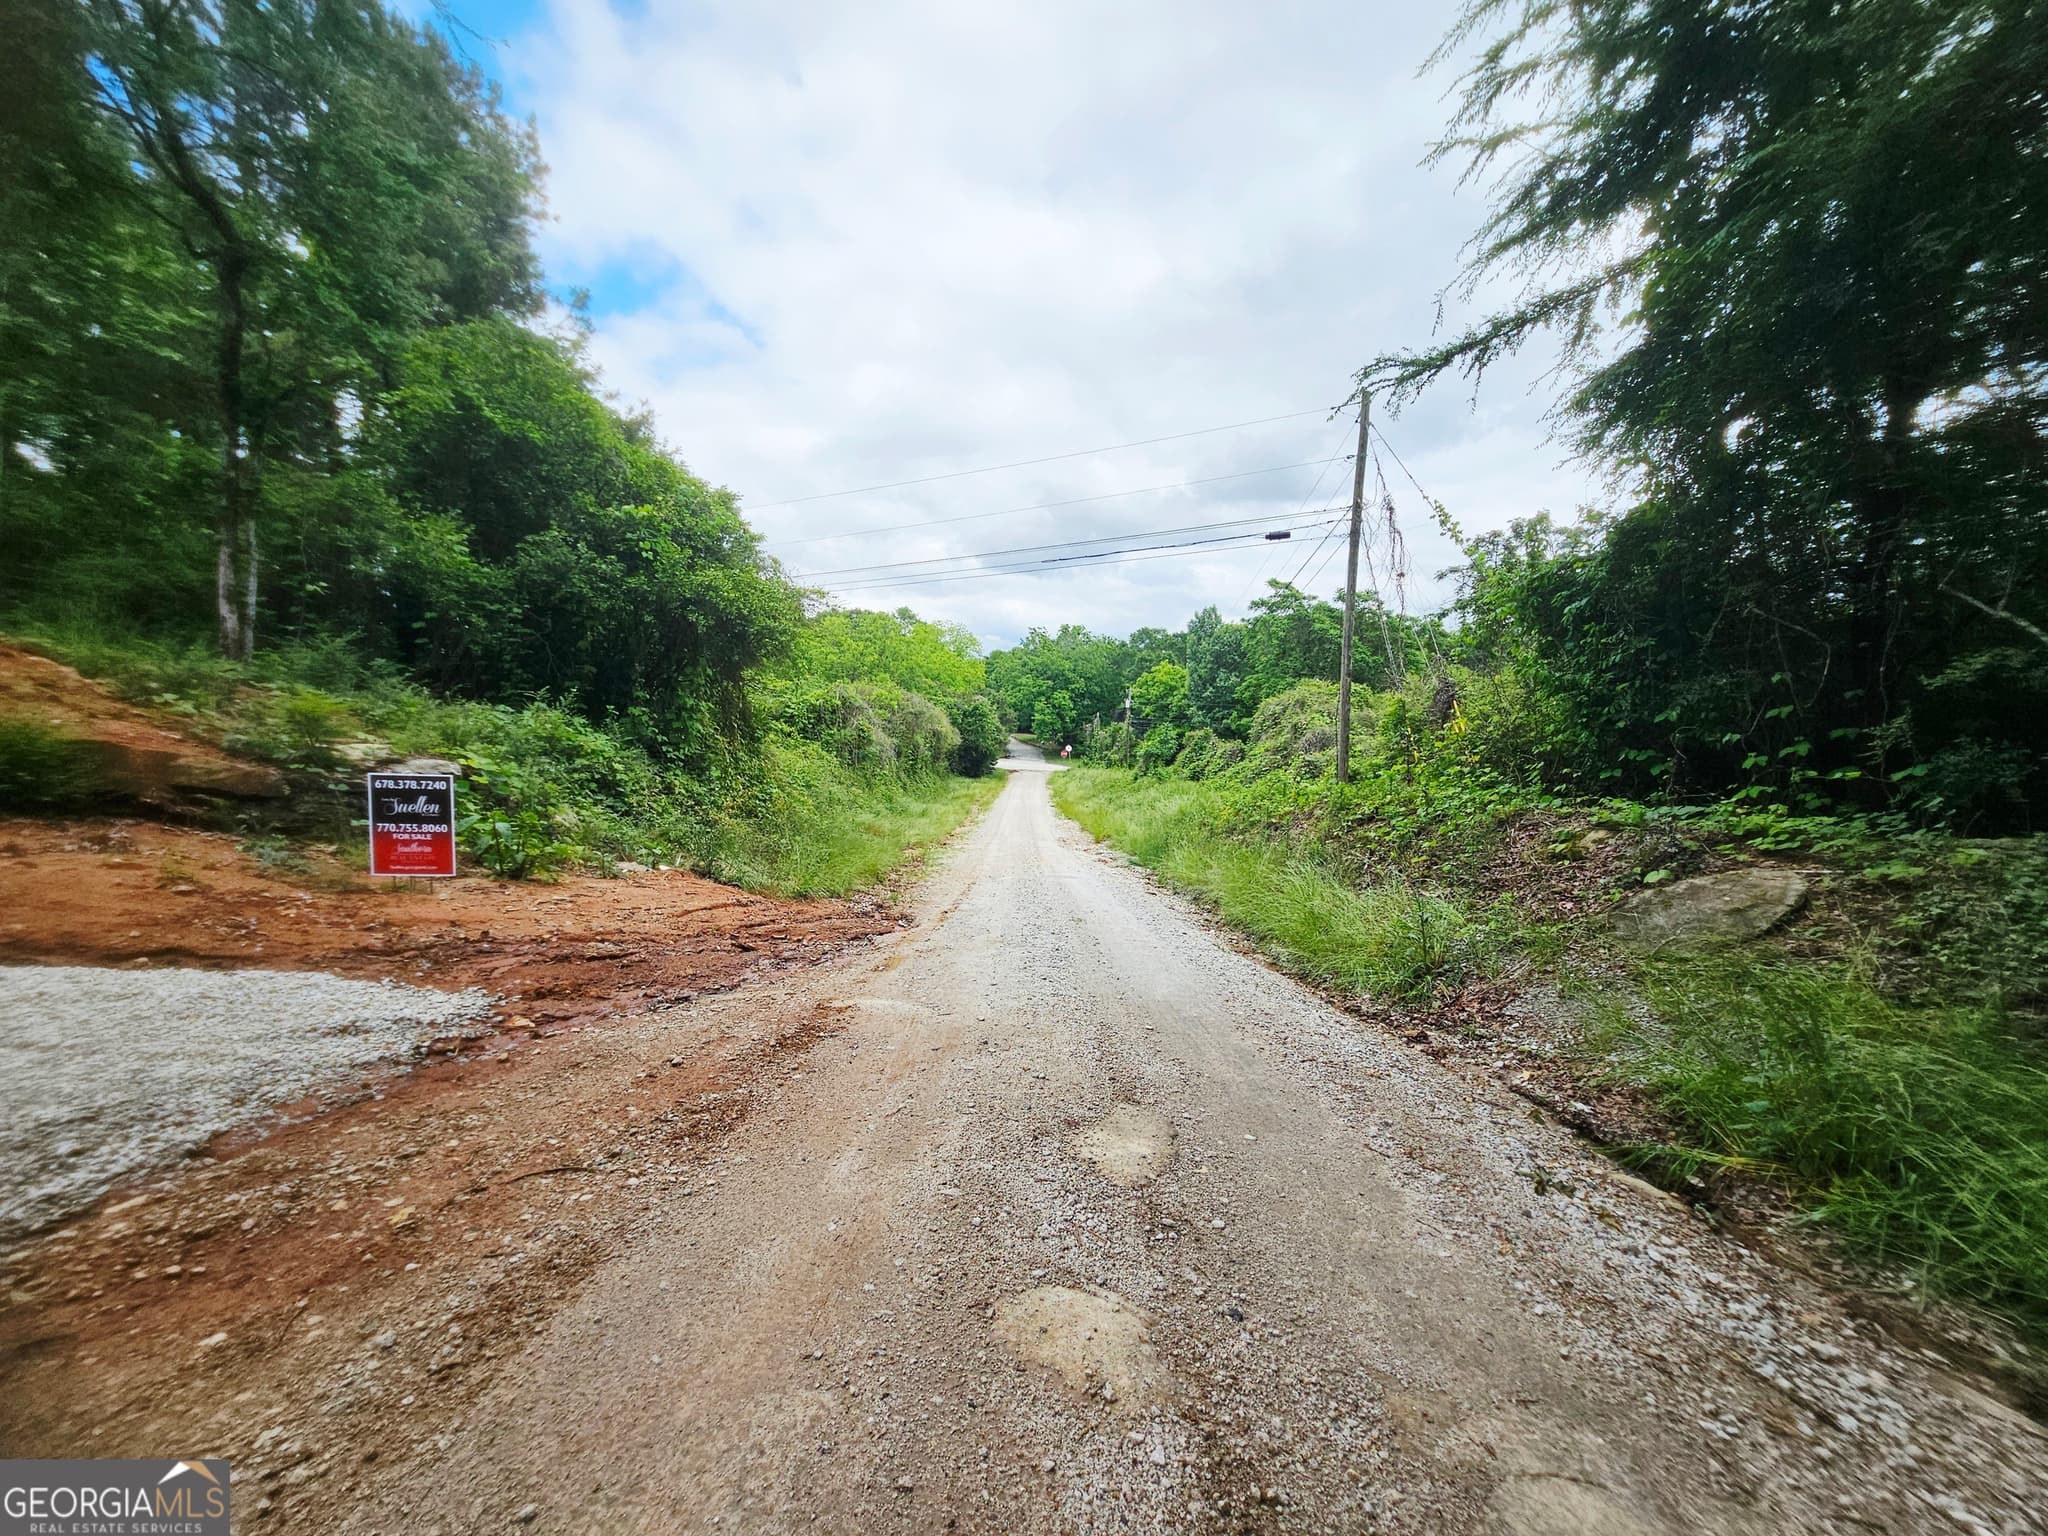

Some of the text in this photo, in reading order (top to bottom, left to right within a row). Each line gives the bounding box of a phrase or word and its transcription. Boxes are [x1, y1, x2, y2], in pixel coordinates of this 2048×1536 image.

[374, 779, 447, 790] 678.378.7240
[384, 795, 441, 816] Suellen
[376, 823, 448, 833] 770.755.8060
